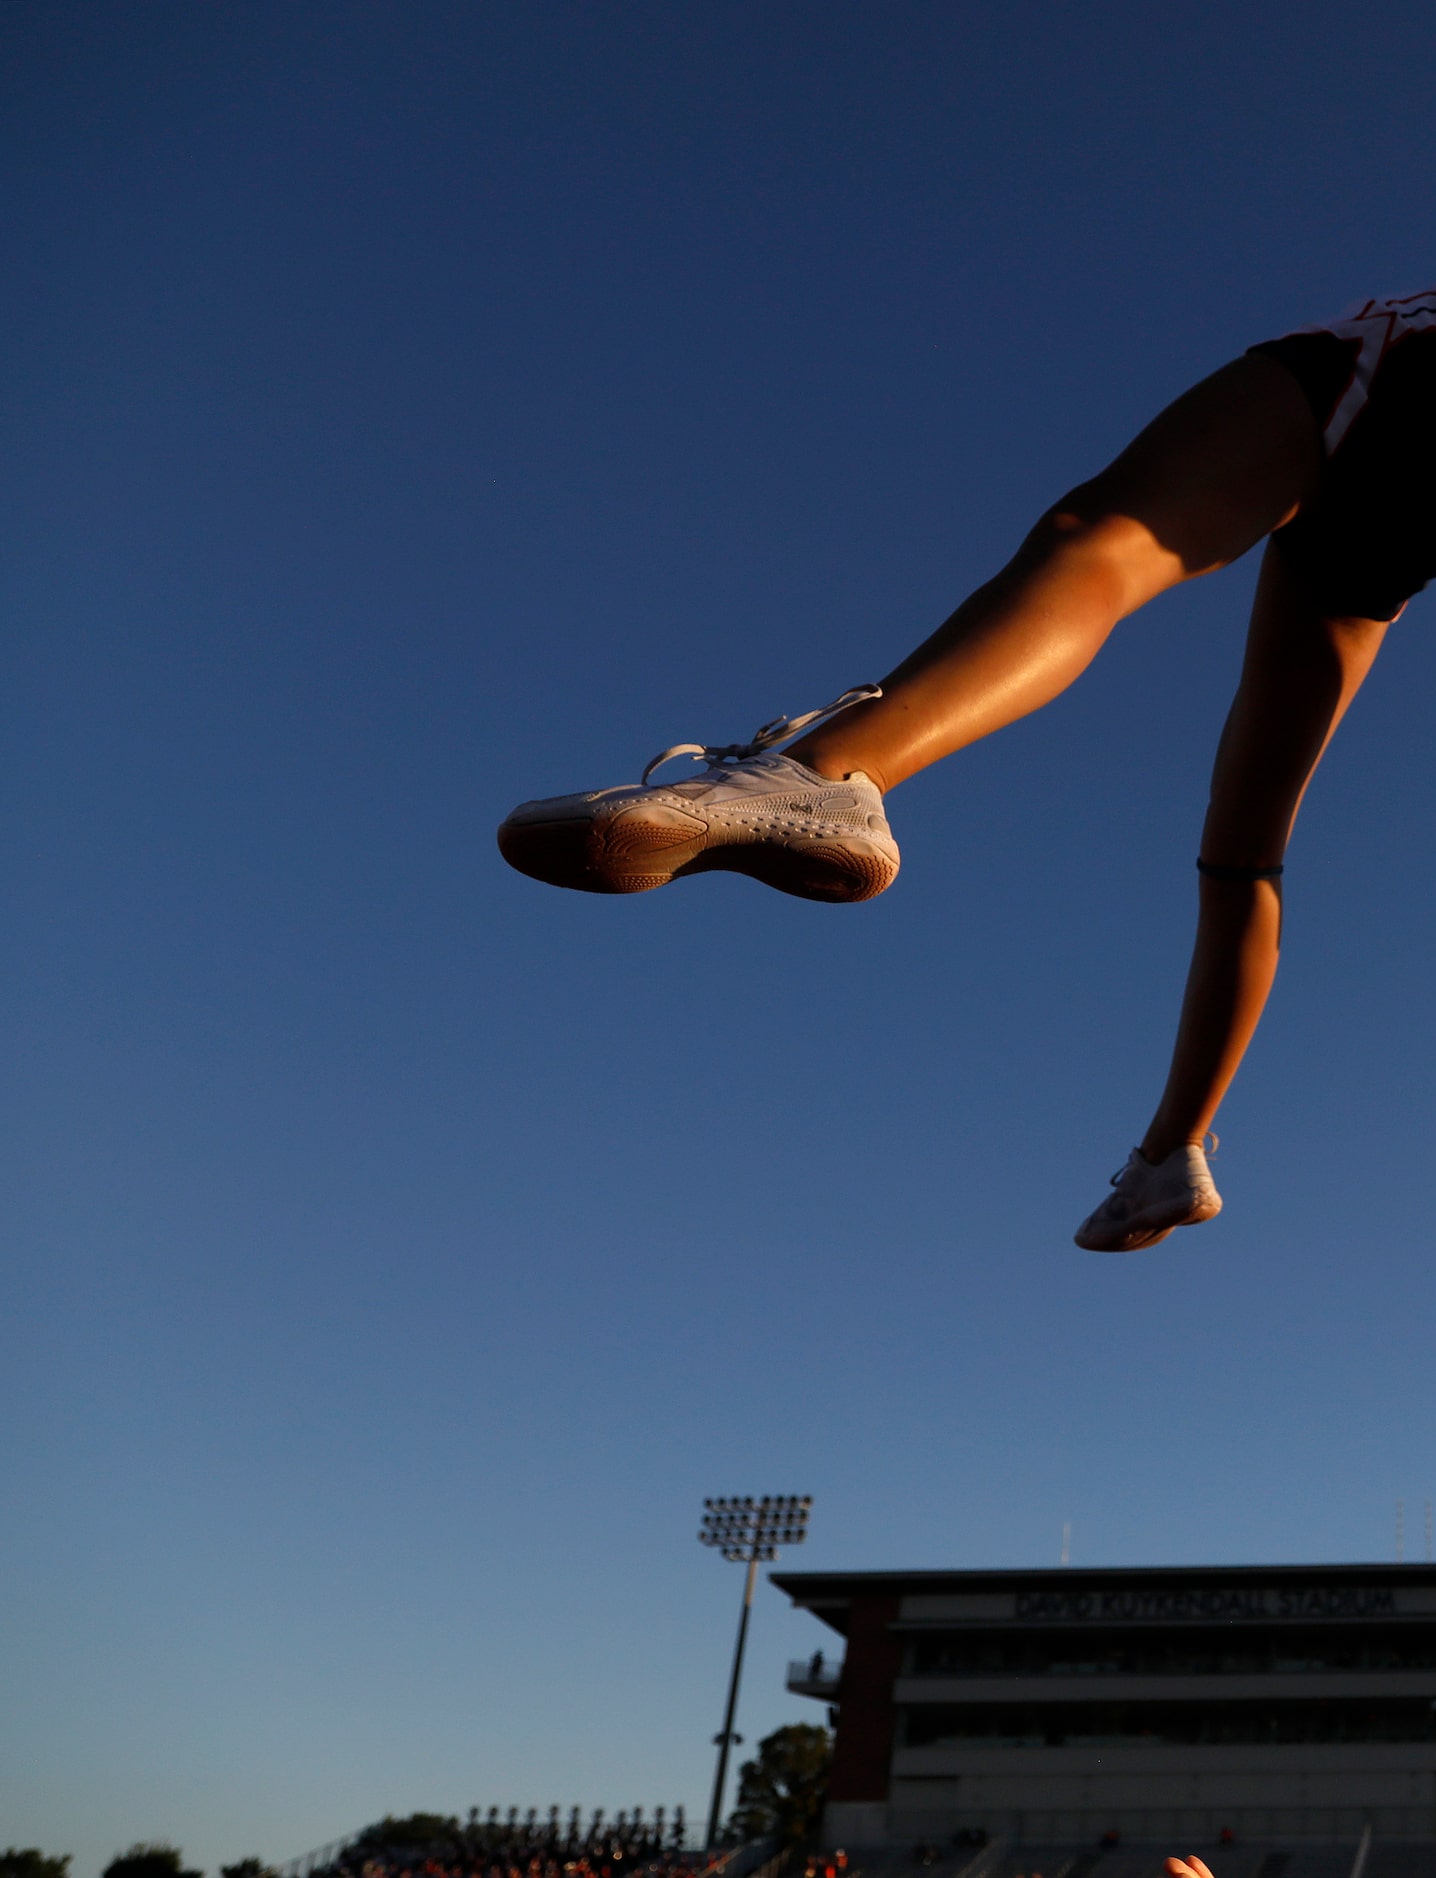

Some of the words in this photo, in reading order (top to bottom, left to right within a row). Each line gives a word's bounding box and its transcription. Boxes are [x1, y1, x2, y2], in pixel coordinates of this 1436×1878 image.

[1015, 1591, 1092, 1617] DAVID
[1101, 1589, 1268, 1616] KUYKENDALL
[1278, 1588, 1396, 1614] STADIUM
